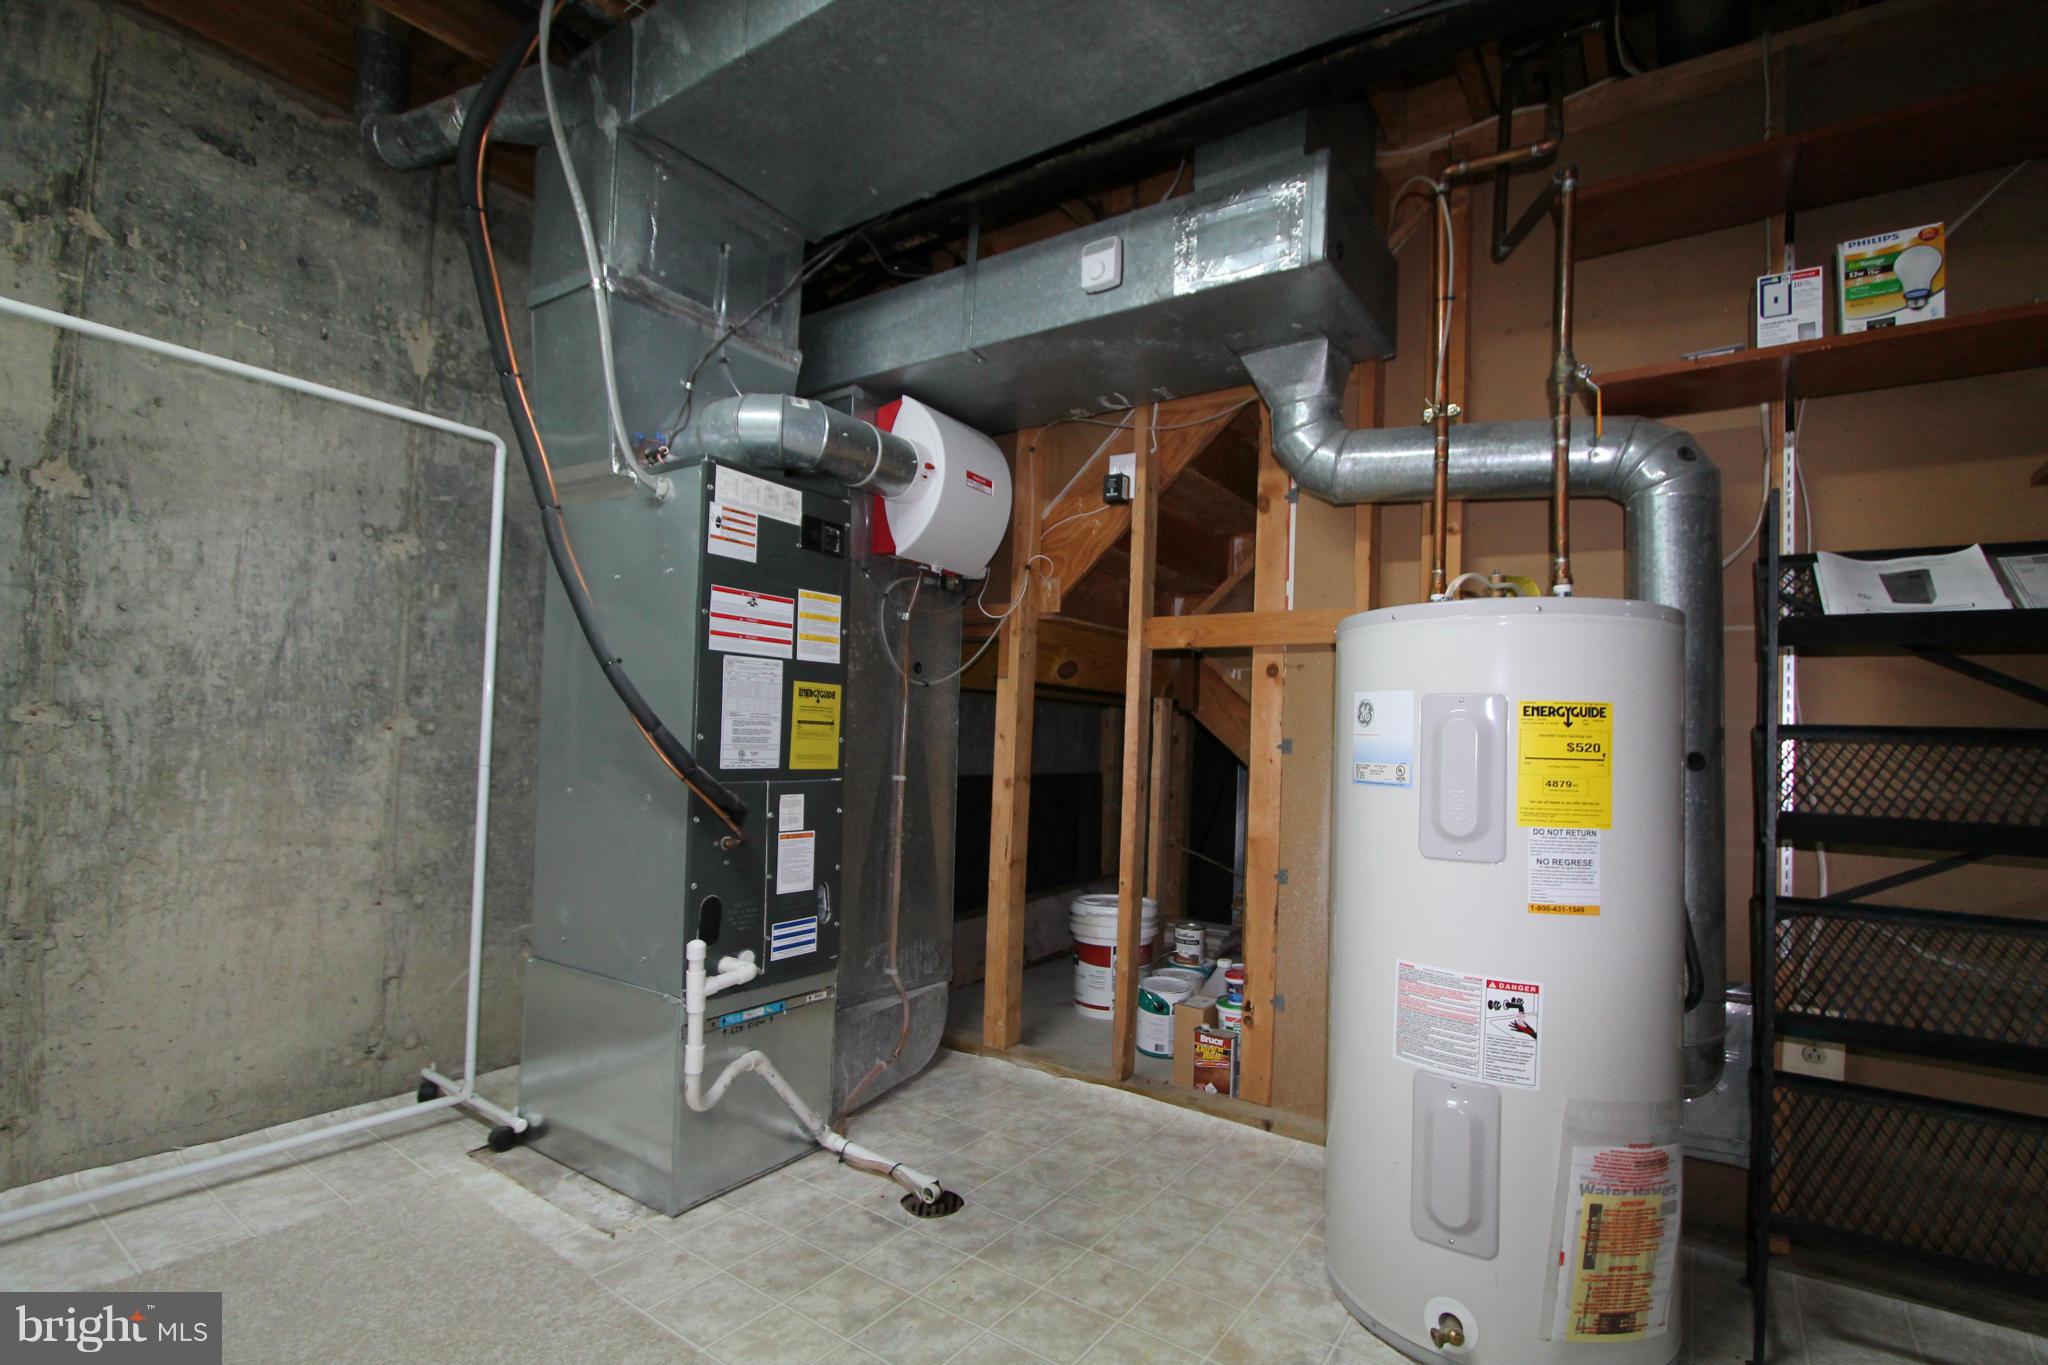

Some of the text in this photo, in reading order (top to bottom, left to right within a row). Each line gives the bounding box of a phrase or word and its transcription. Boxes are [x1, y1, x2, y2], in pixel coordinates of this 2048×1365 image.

[1848, 233, 1900, 248] PHILIPS
[1523, 705, 1607, 719] ENERGYGUIDE
[1566, 743, 1601, 753] $520
[1545, 780, 1572, 788] 4879
[1532, 828, 1597, 837] DO NOT RETURN
[1552, 858, 1593, 867] REGRESE
[1498, 982, 1537, 993] DANGER
[1200, 1034, 1224, 1047] Bruce
